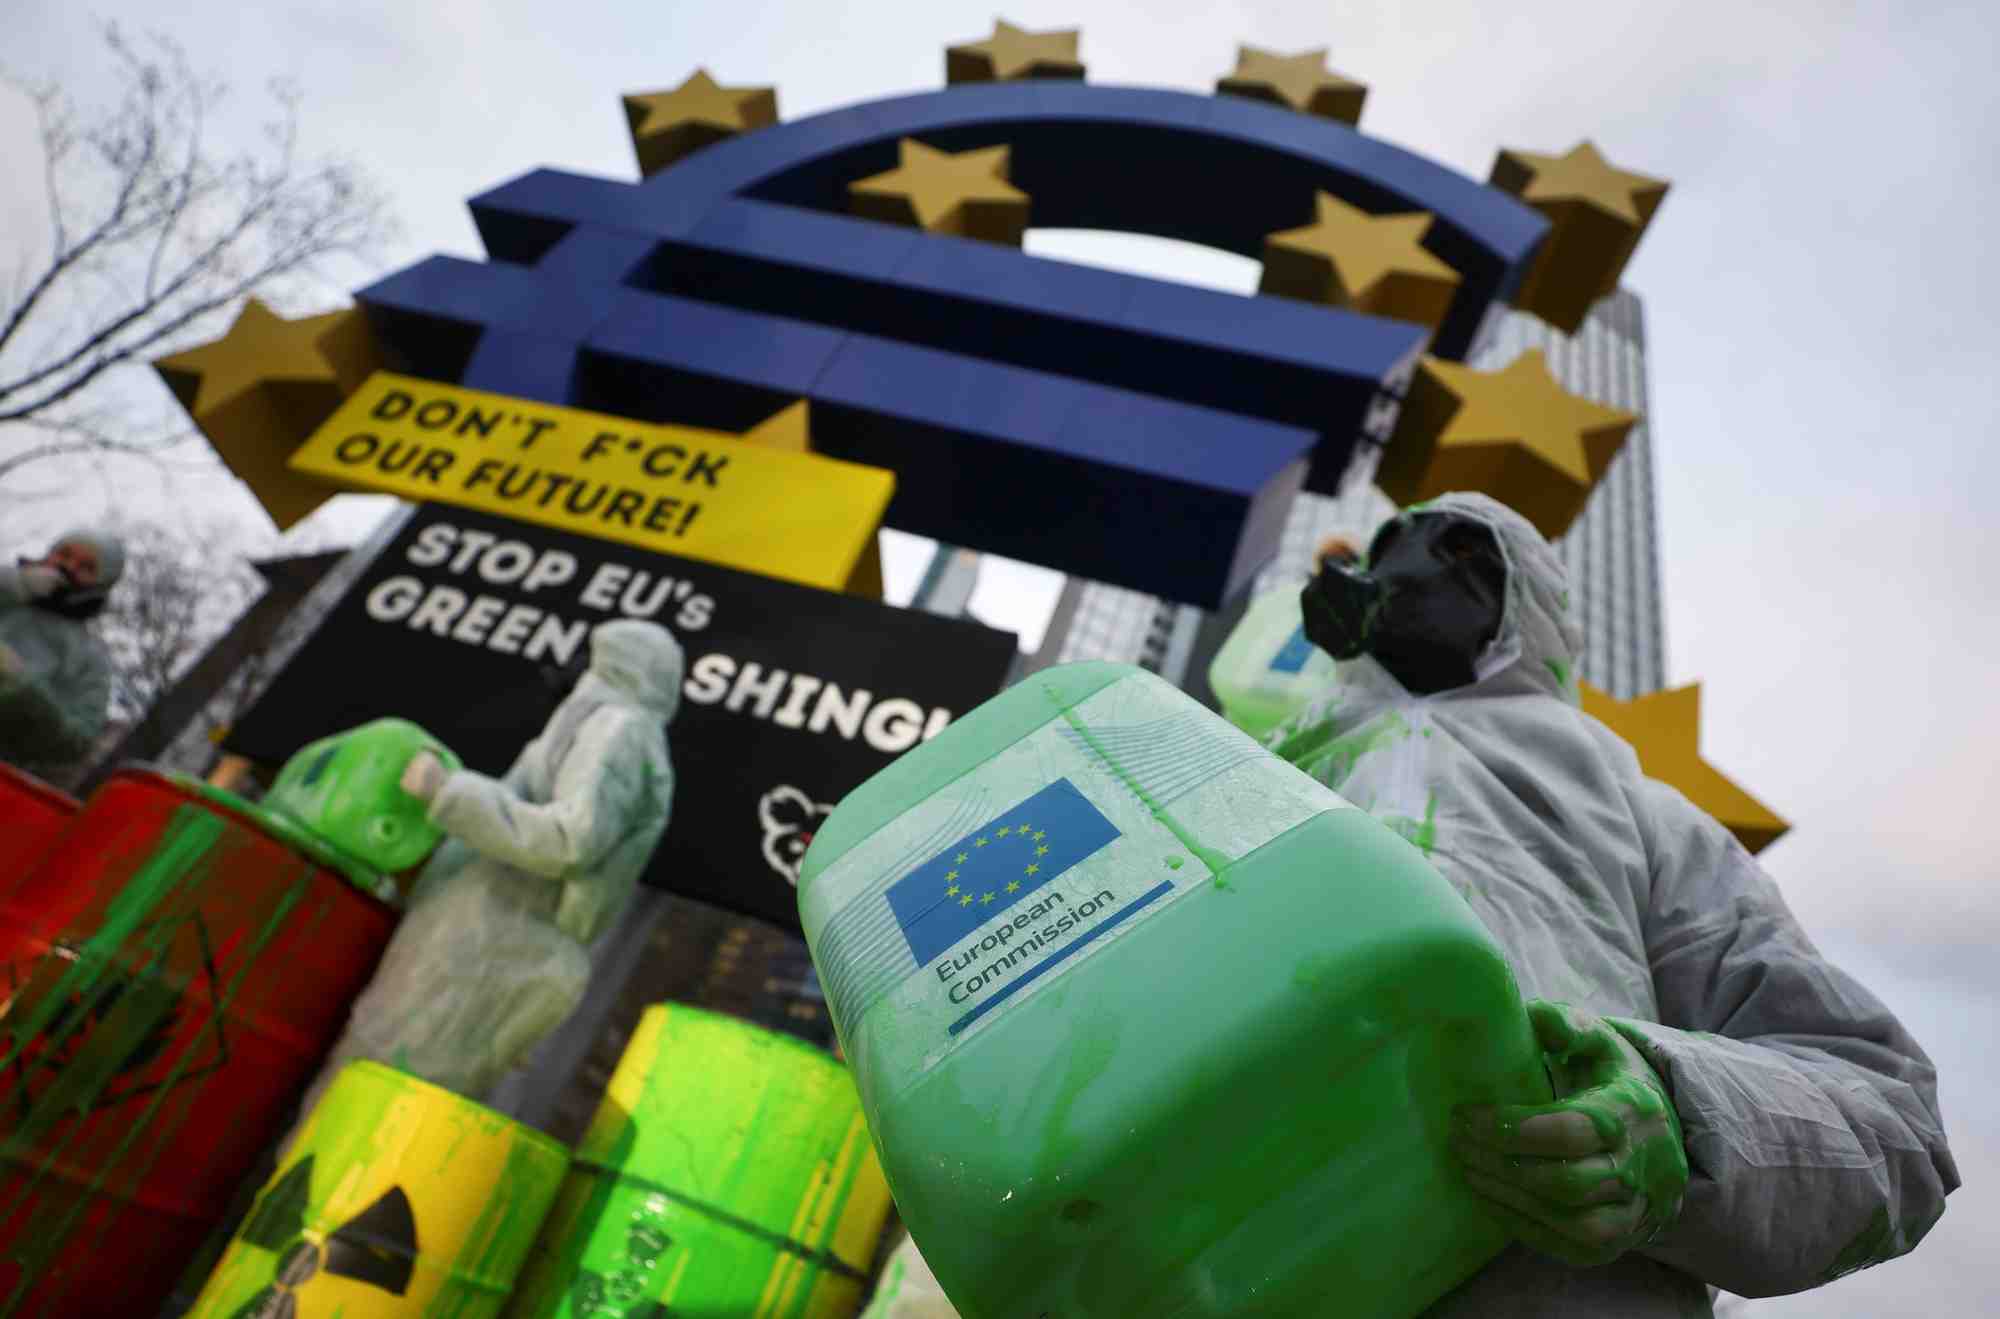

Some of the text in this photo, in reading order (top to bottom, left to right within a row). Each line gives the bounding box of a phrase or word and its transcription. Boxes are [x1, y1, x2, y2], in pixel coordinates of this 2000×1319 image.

[371, 390, 557, 449] DON'T
[335, 433, 701, 537] OUR FUTURE!
[406, 523, 715, 630] STOP EU's
[935, 890, 1064, 983] European
[947, 886, 1115, 1005] Commission
